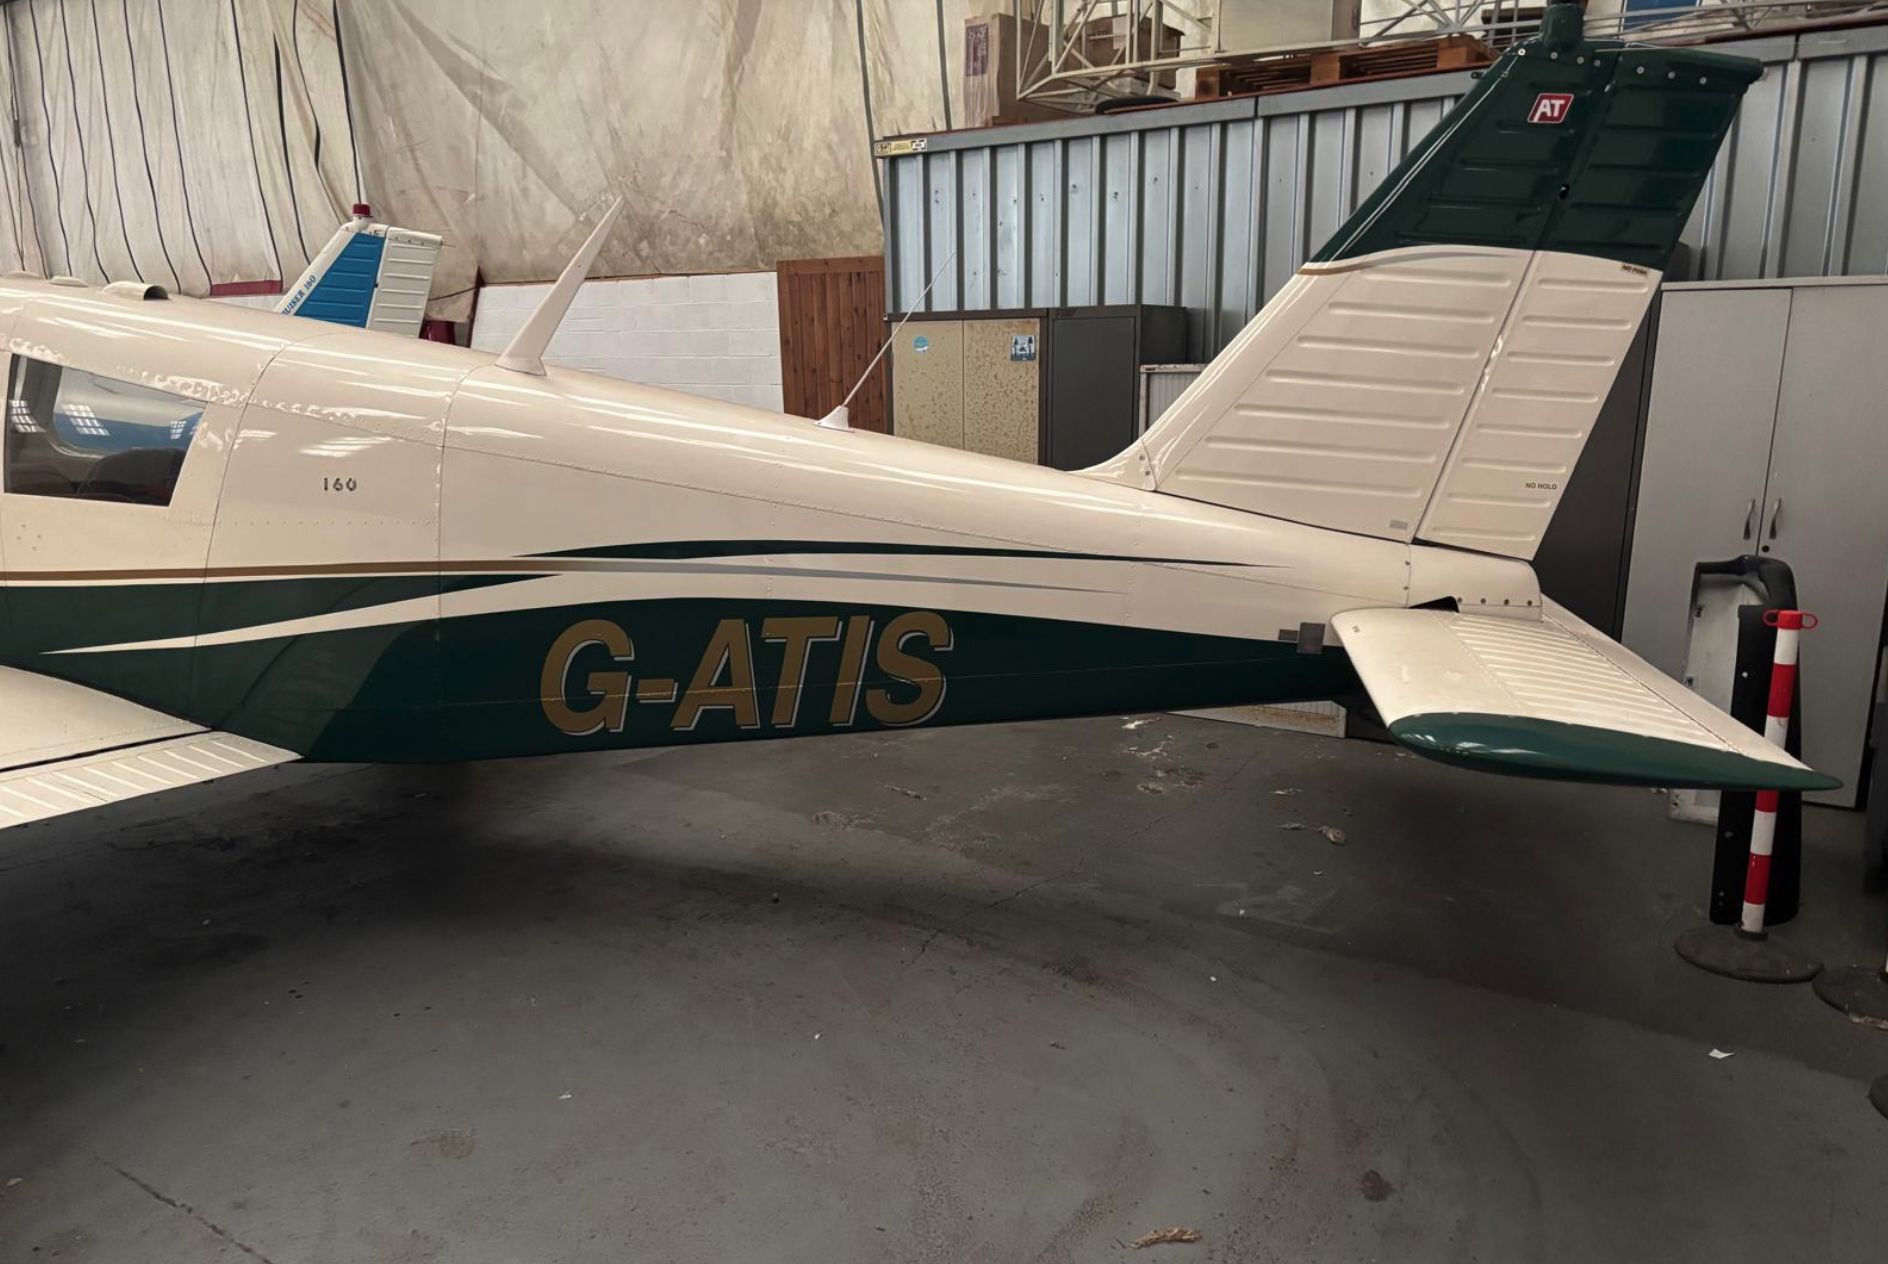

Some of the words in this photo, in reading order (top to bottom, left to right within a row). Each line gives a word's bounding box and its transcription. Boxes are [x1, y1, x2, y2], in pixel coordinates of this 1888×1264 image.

[1533, 99, 1566, 122] AT
[304, 274, 316, 290] 160
[323, 477, 357, 491] 160
[540, 611, 954, 736] G-ATIS
